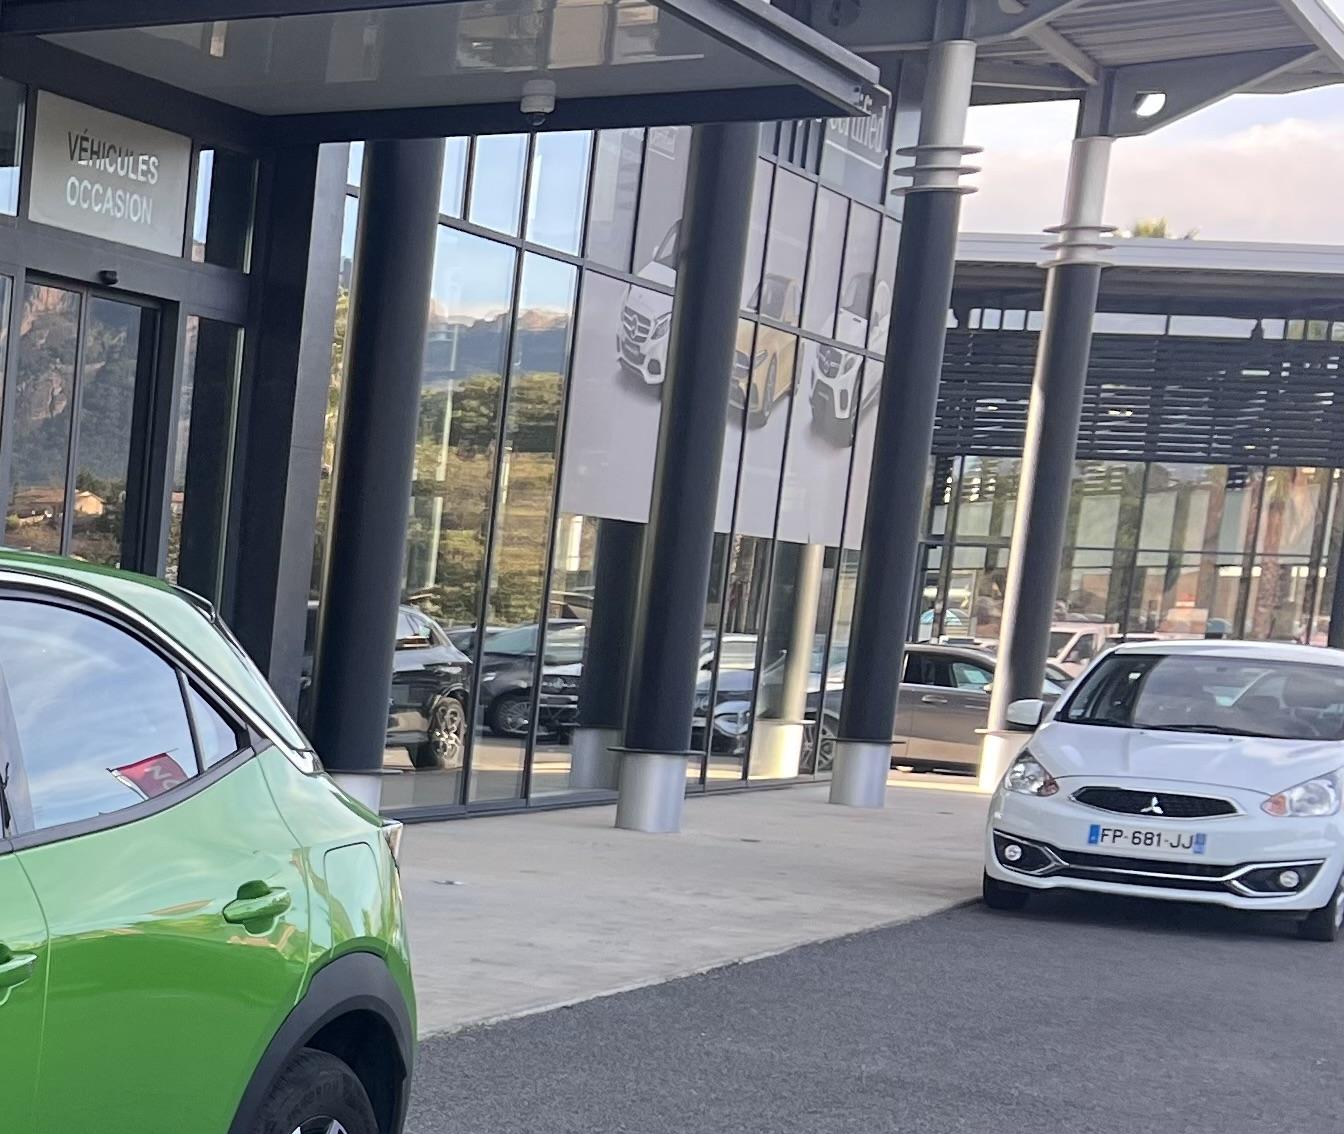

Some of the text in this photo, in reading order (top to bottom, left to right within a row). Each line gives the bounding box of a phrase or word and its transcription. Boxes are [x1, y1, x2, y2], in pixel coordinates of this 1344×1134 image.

[67, 128, 160, 185] VÉHICULES
[66, 176, 153, 225] OCCASION
[1100, 827, 1194, 850] FP-681-JJ
